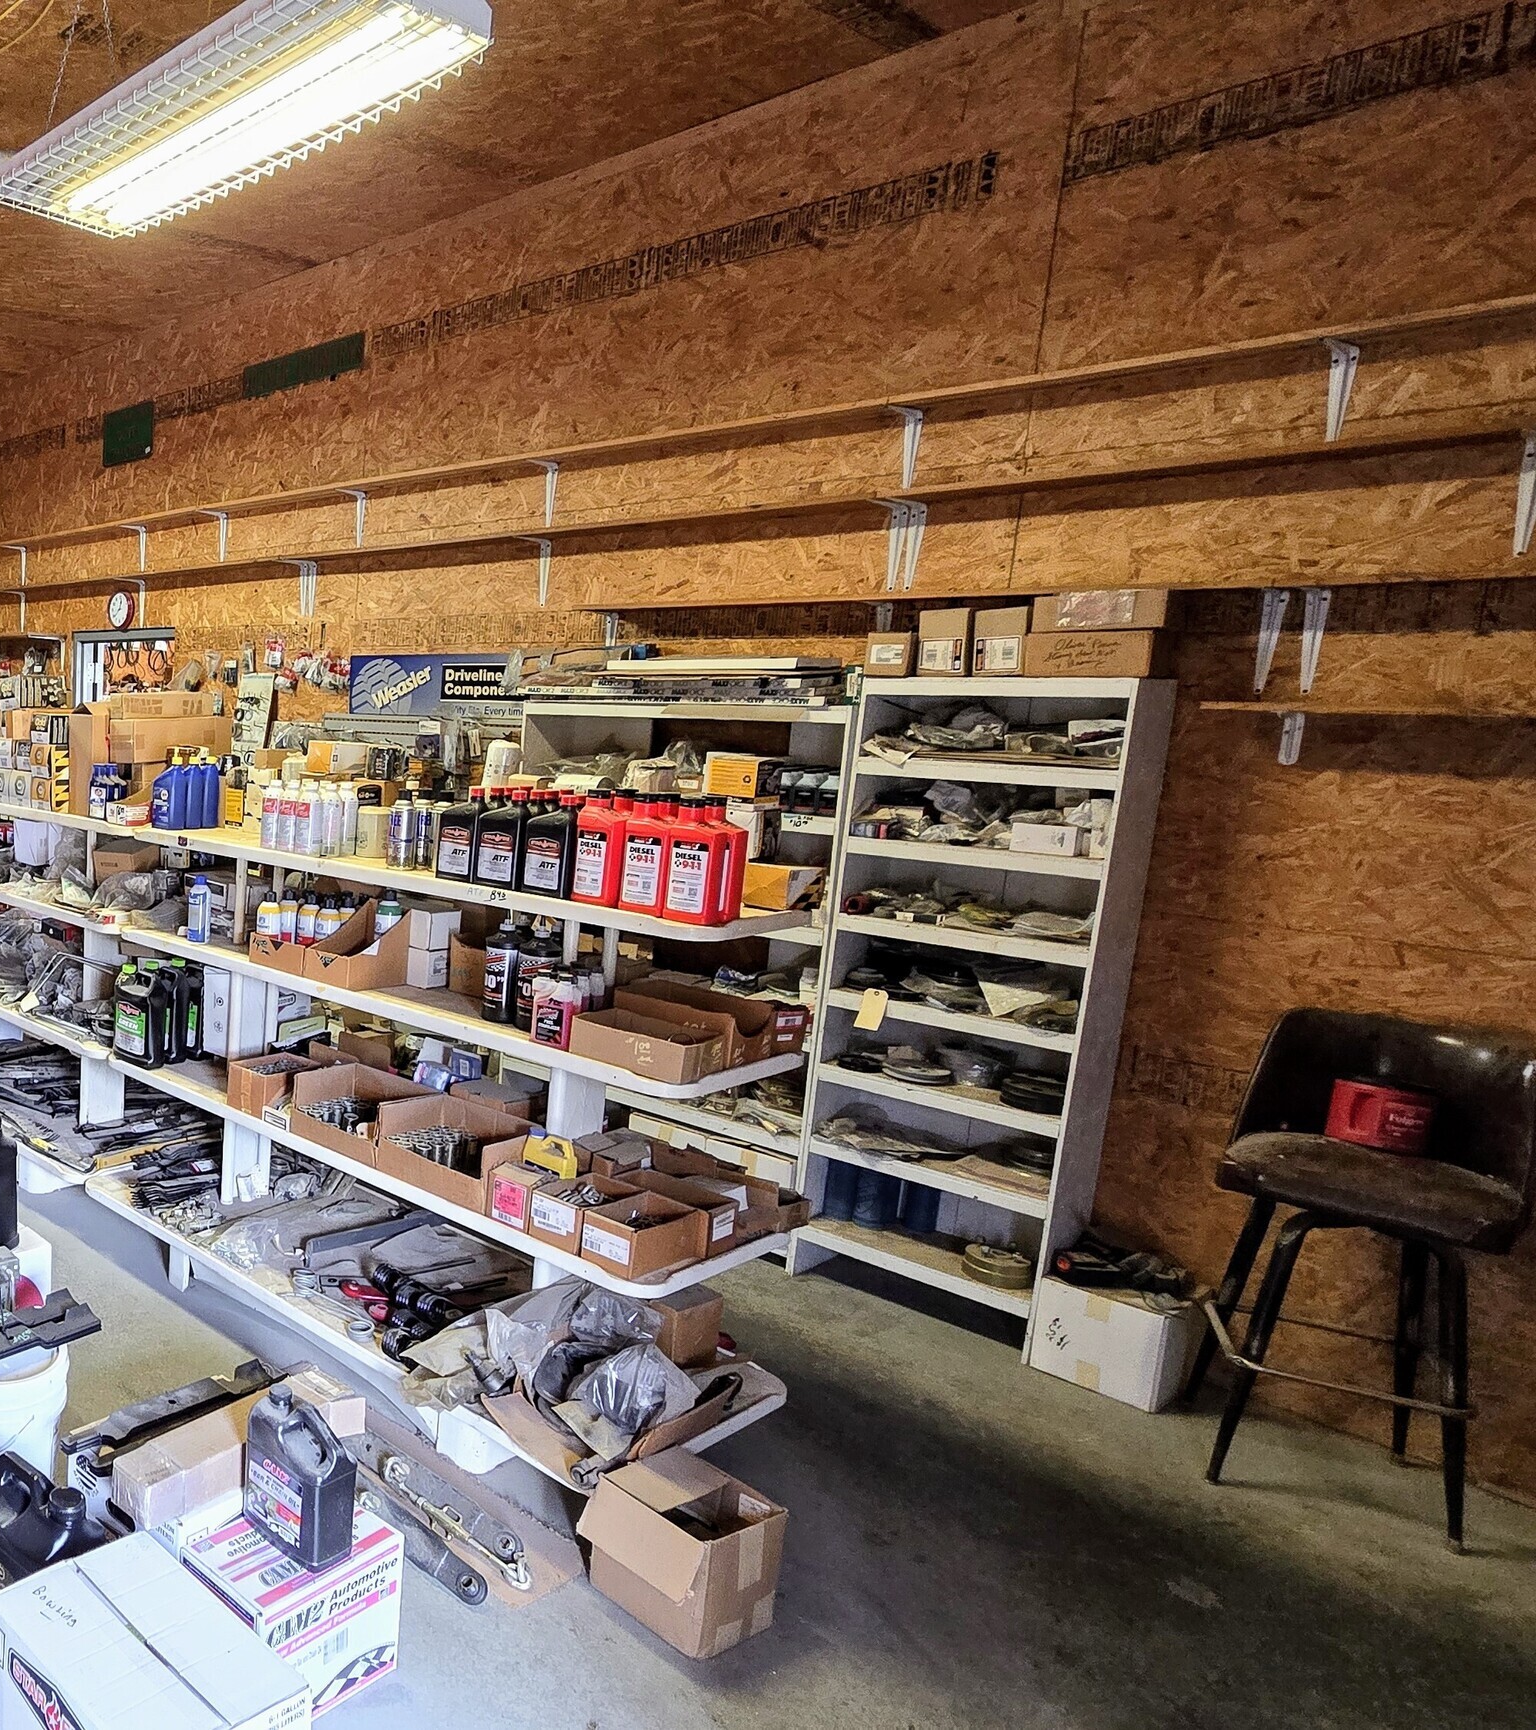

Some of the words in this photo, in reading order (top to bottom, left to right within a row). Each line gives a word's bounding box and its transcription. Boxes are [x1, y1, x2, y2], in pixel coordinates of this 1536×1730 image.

[445, 668, 503, 682] Driveline
[371, 665, 432, 709] Weasler
[444, 683, 525, 697] Compone
[483, 706, 506, 717] Every
[580, 840, 602, 850] DIESEL
[629, 846, 655, 856] DIESEL
[451, 848, 467, 857] ATF
[492, 854, 510, 863] ATF
[675, 851, 702, 862] DIESEL
[538, 861, 556, 870] ATF
[118, 1017, 139, 1031] GREEN
[229, 1528, 263, 1547] ducts
[227, 1537, 267, 1558] omotive
[257, 1560, 305, 1587] CAM
[329, 1557, 398, 1603] Automotive
[328, 1575, 386, 1616] Products
[265, 1597, 326, 1649] CAM2
[13, 1657, 46, 1711] STAR
